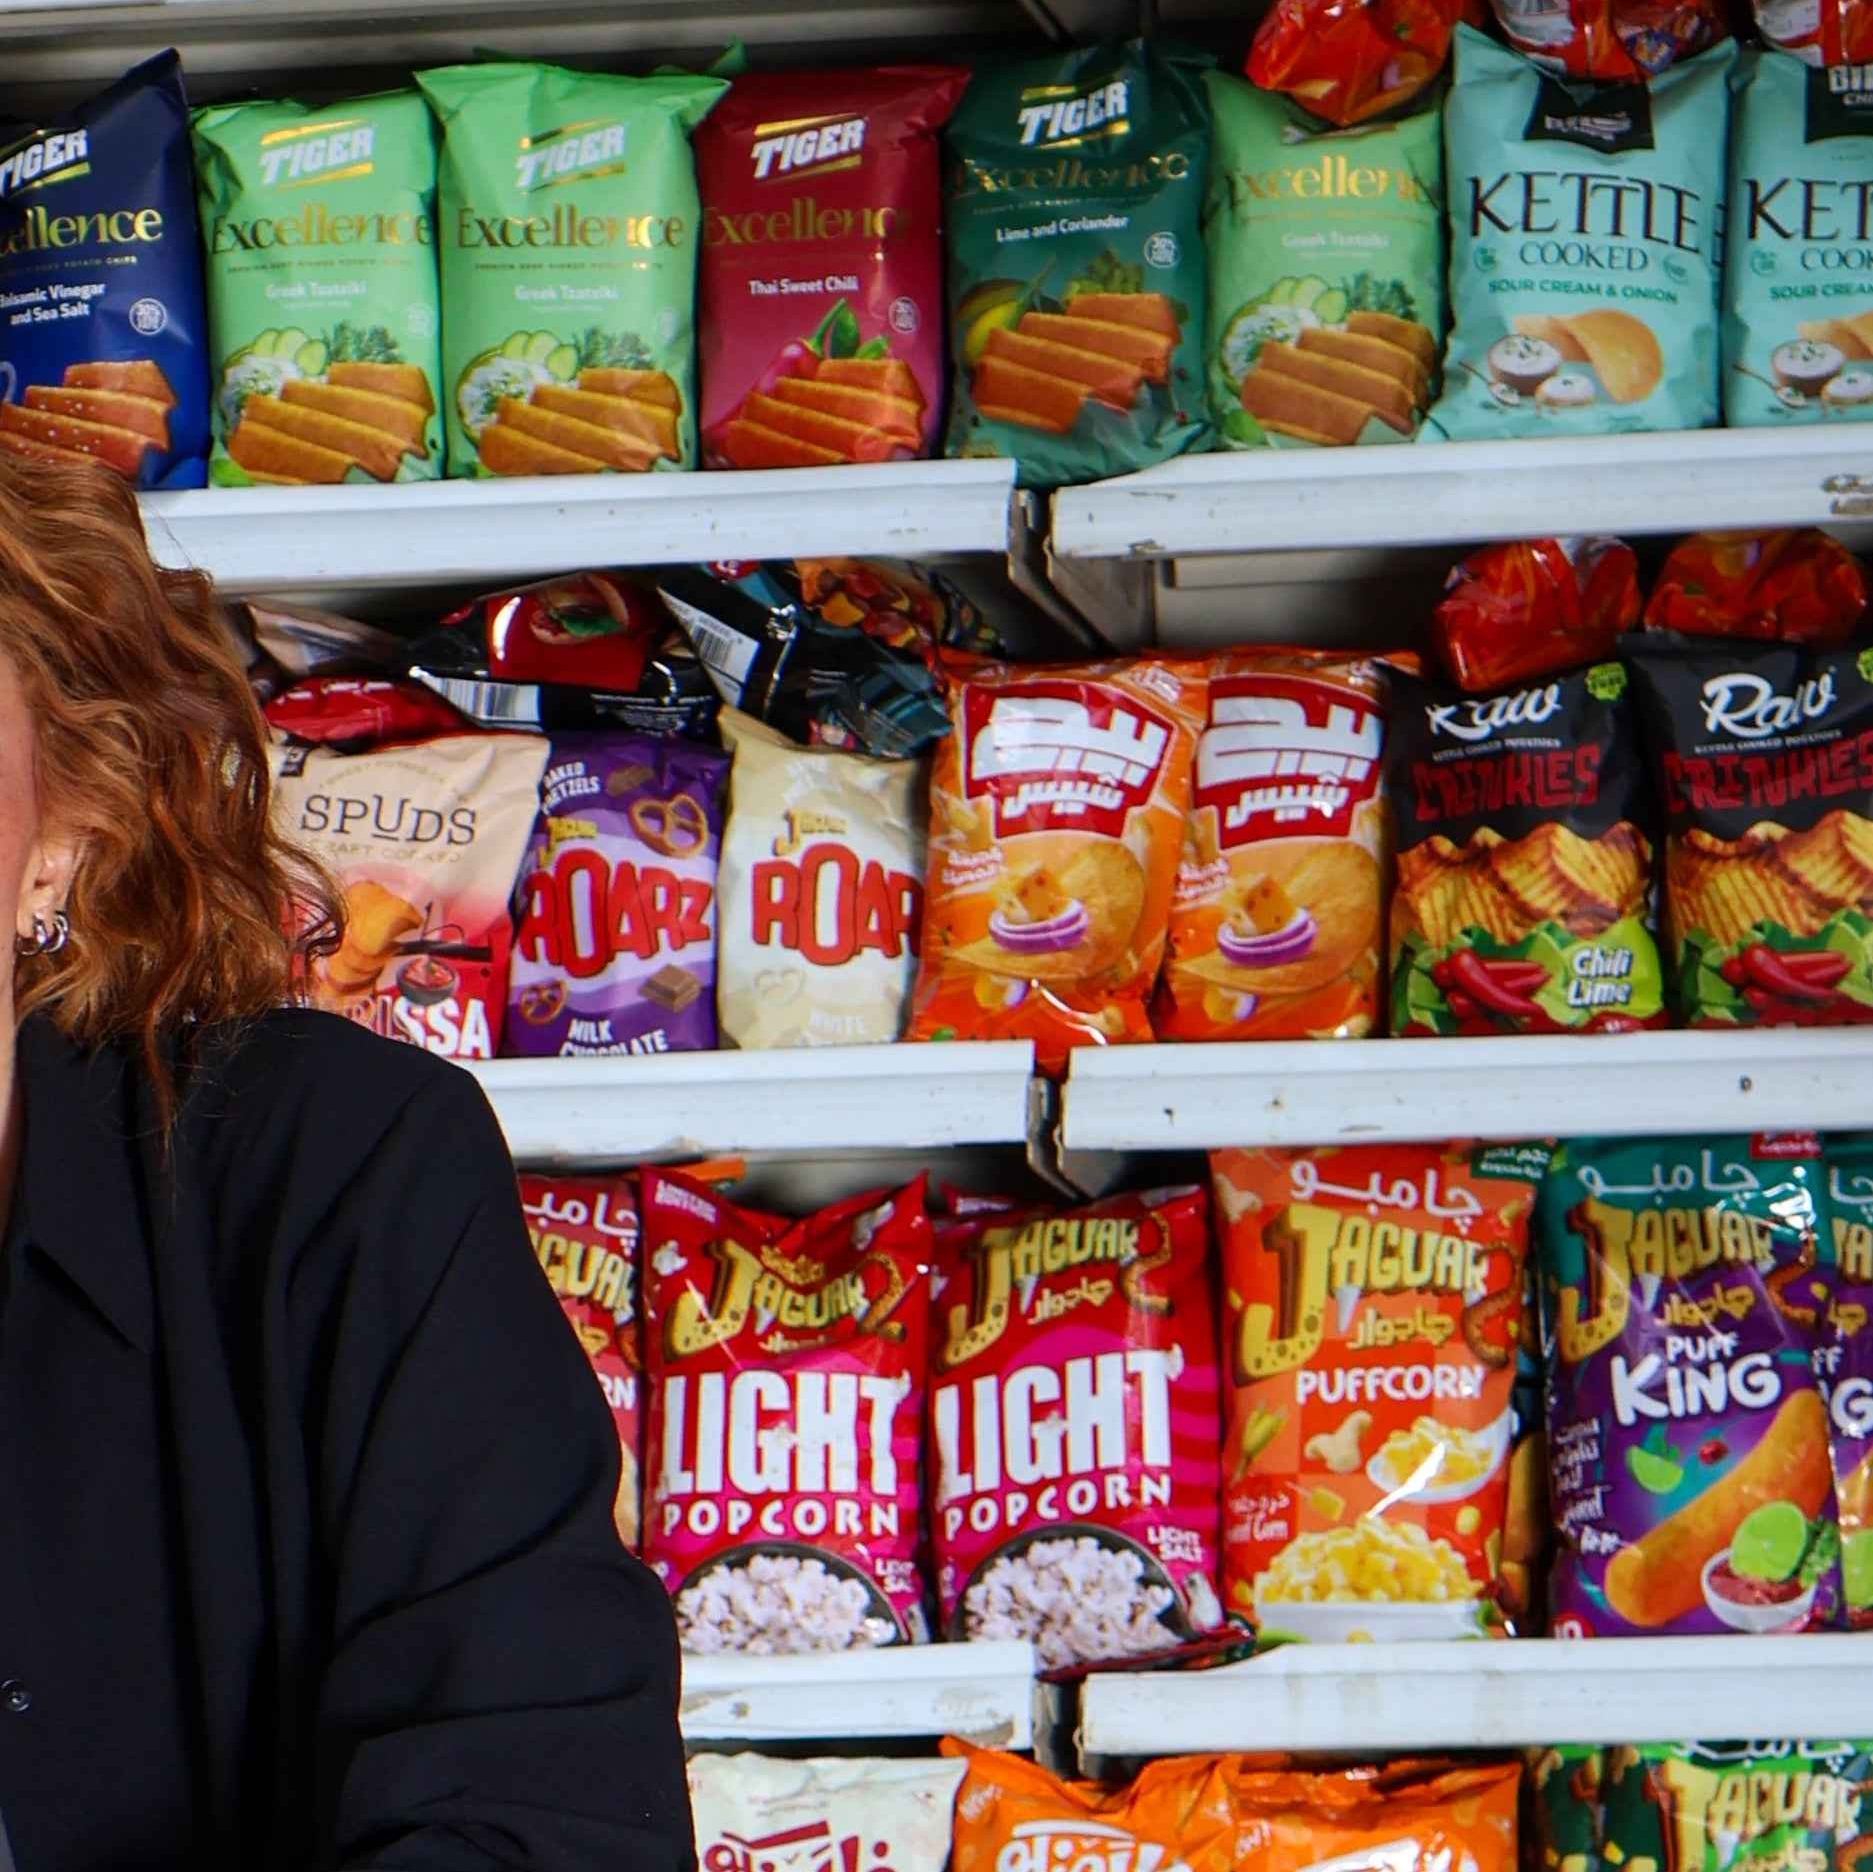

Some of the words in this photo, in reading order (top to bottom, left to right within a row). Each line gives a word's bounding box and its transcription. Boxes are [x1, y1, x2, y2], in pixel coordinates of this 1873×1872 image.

[1018, 80, 1129, 145] TIGER
[259, 126, 374, 188] TIGER
[516, 124, 625, 189] TIGER
[751, 117, 865, 180] TIGER
[211, 203, 429, 256] Excellence
[456, 203, 684, 250] Excellence
[996, 225, 1028, 243] Lime
[1031, 221, 1057, 237] and
[1059, 215, 1129, 234] Coriander
[1468, 171, 1700, 253] KETTLE
[749, 279, 777, 295] Thai
[780, 277, 822, 294] Sweet
[824, 275, 858, 292] Chili
[1519, 243, 1648, 271] COOKED
[33, 306, 58, 324] Sea
[60, 302, 90, 320] Salt
[49, 281, 106, 303] Vinegar
[266, 281, 306, 299] Greek
[514, 285, 557, 302] Greek
[1488, 279, 1536, 294] SOUR
[1538, 280, 1602, 297] CREAM
[1621, 284, 1678, 305] ONION
[1770, 284, 1817, 300] SOUR
[1426, 682, 1562, 741] Raw
[1701, 668, 1838, 741] Raw
[1413, 744, 1601, 822] CRINKLES
[1663, 727, 1873, 815] CRINKLES
[301, 794, 476, 845] SPUDS
[519, 848, 712, 977] ROARZ
[752, 843, 923, 967] ROAR
[1573, 946, 1632, 977] Chili
[1568, 976, 1632, 1007] Lime
[568, 1019, 612, 1043] MILK
[944, 1216, 1140, 1371] JAGUAR
[1238, 1202, 1486, 1385] JAGUAR
[1560, 1196, 1778, 1363] JAGUAR
[1665, 1332, 1738, 1362] PUFF
[1295, 1364, 1484, 1405] PUFFCORN
[1610, 1352, 1782, 1425] KING
[657, 1370, 911, 1502] LIGHT
[933, 1344, 1184, 1510] LIGHT
[662, 1498, 899, 1537] POPCORN
[945, 1474, 1172, 1541] POPCORN
